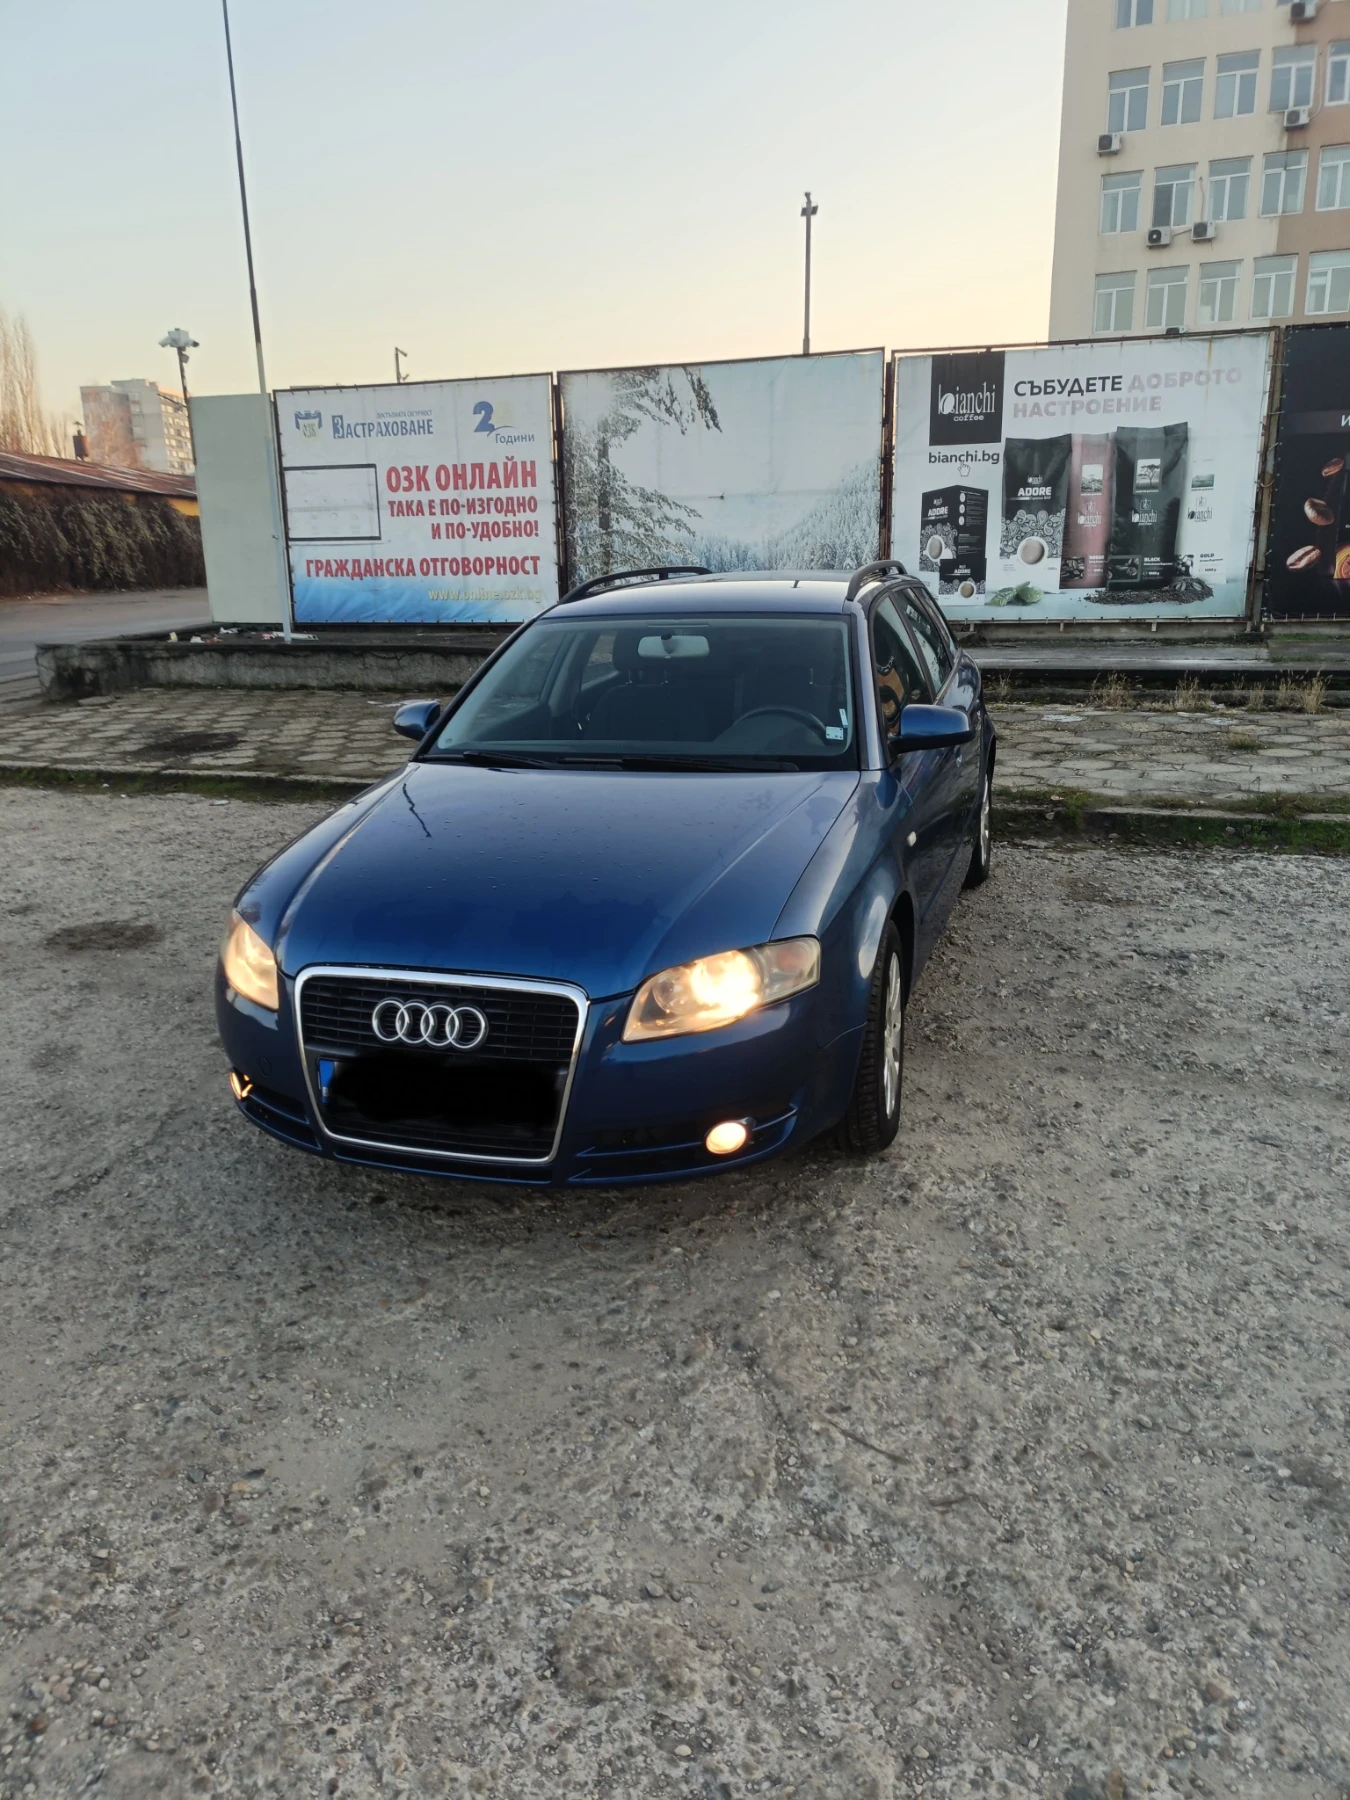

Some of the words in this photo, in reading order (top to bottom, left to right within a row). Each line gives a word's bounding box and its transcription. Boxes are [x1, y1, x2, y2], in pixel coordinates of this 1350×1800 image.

[1014, 375, 1123, 397] СЪБУДЕТЕ
[1127, 367, 1243, 393] ДОБРОТО
[938, 381, 996, 414] bianchi
[1013, 395, 1162, 418] НАСТРОЕНИЕ
[332, 415, 434, 439] ЗАСТРАХОВАНЕ
[495, 434, 535, 445] Години
[928, 450, 1000, 465] bianchi.bg
[386, 465, 431, 493] ОЗК
[435, 455, 537, 491] ОНЛАЙН
[1017, 487, 1052, 496] ADORE
[388, 499, 425, 517] ТАКА
[428, 499, 437, 516] Е
[440, 496, 538, 517] ПО-ИЗГОДНО
[928, 506, 948, 517] ADORE
[431, 523, 441, 540] И
[445, 520, 539, 542] ПО-УДОБНО!
[305, 558, 417, 580] ГРАЖДАНСКА
[419, 556, 541, 577] ОТГОВОРНОСТ
